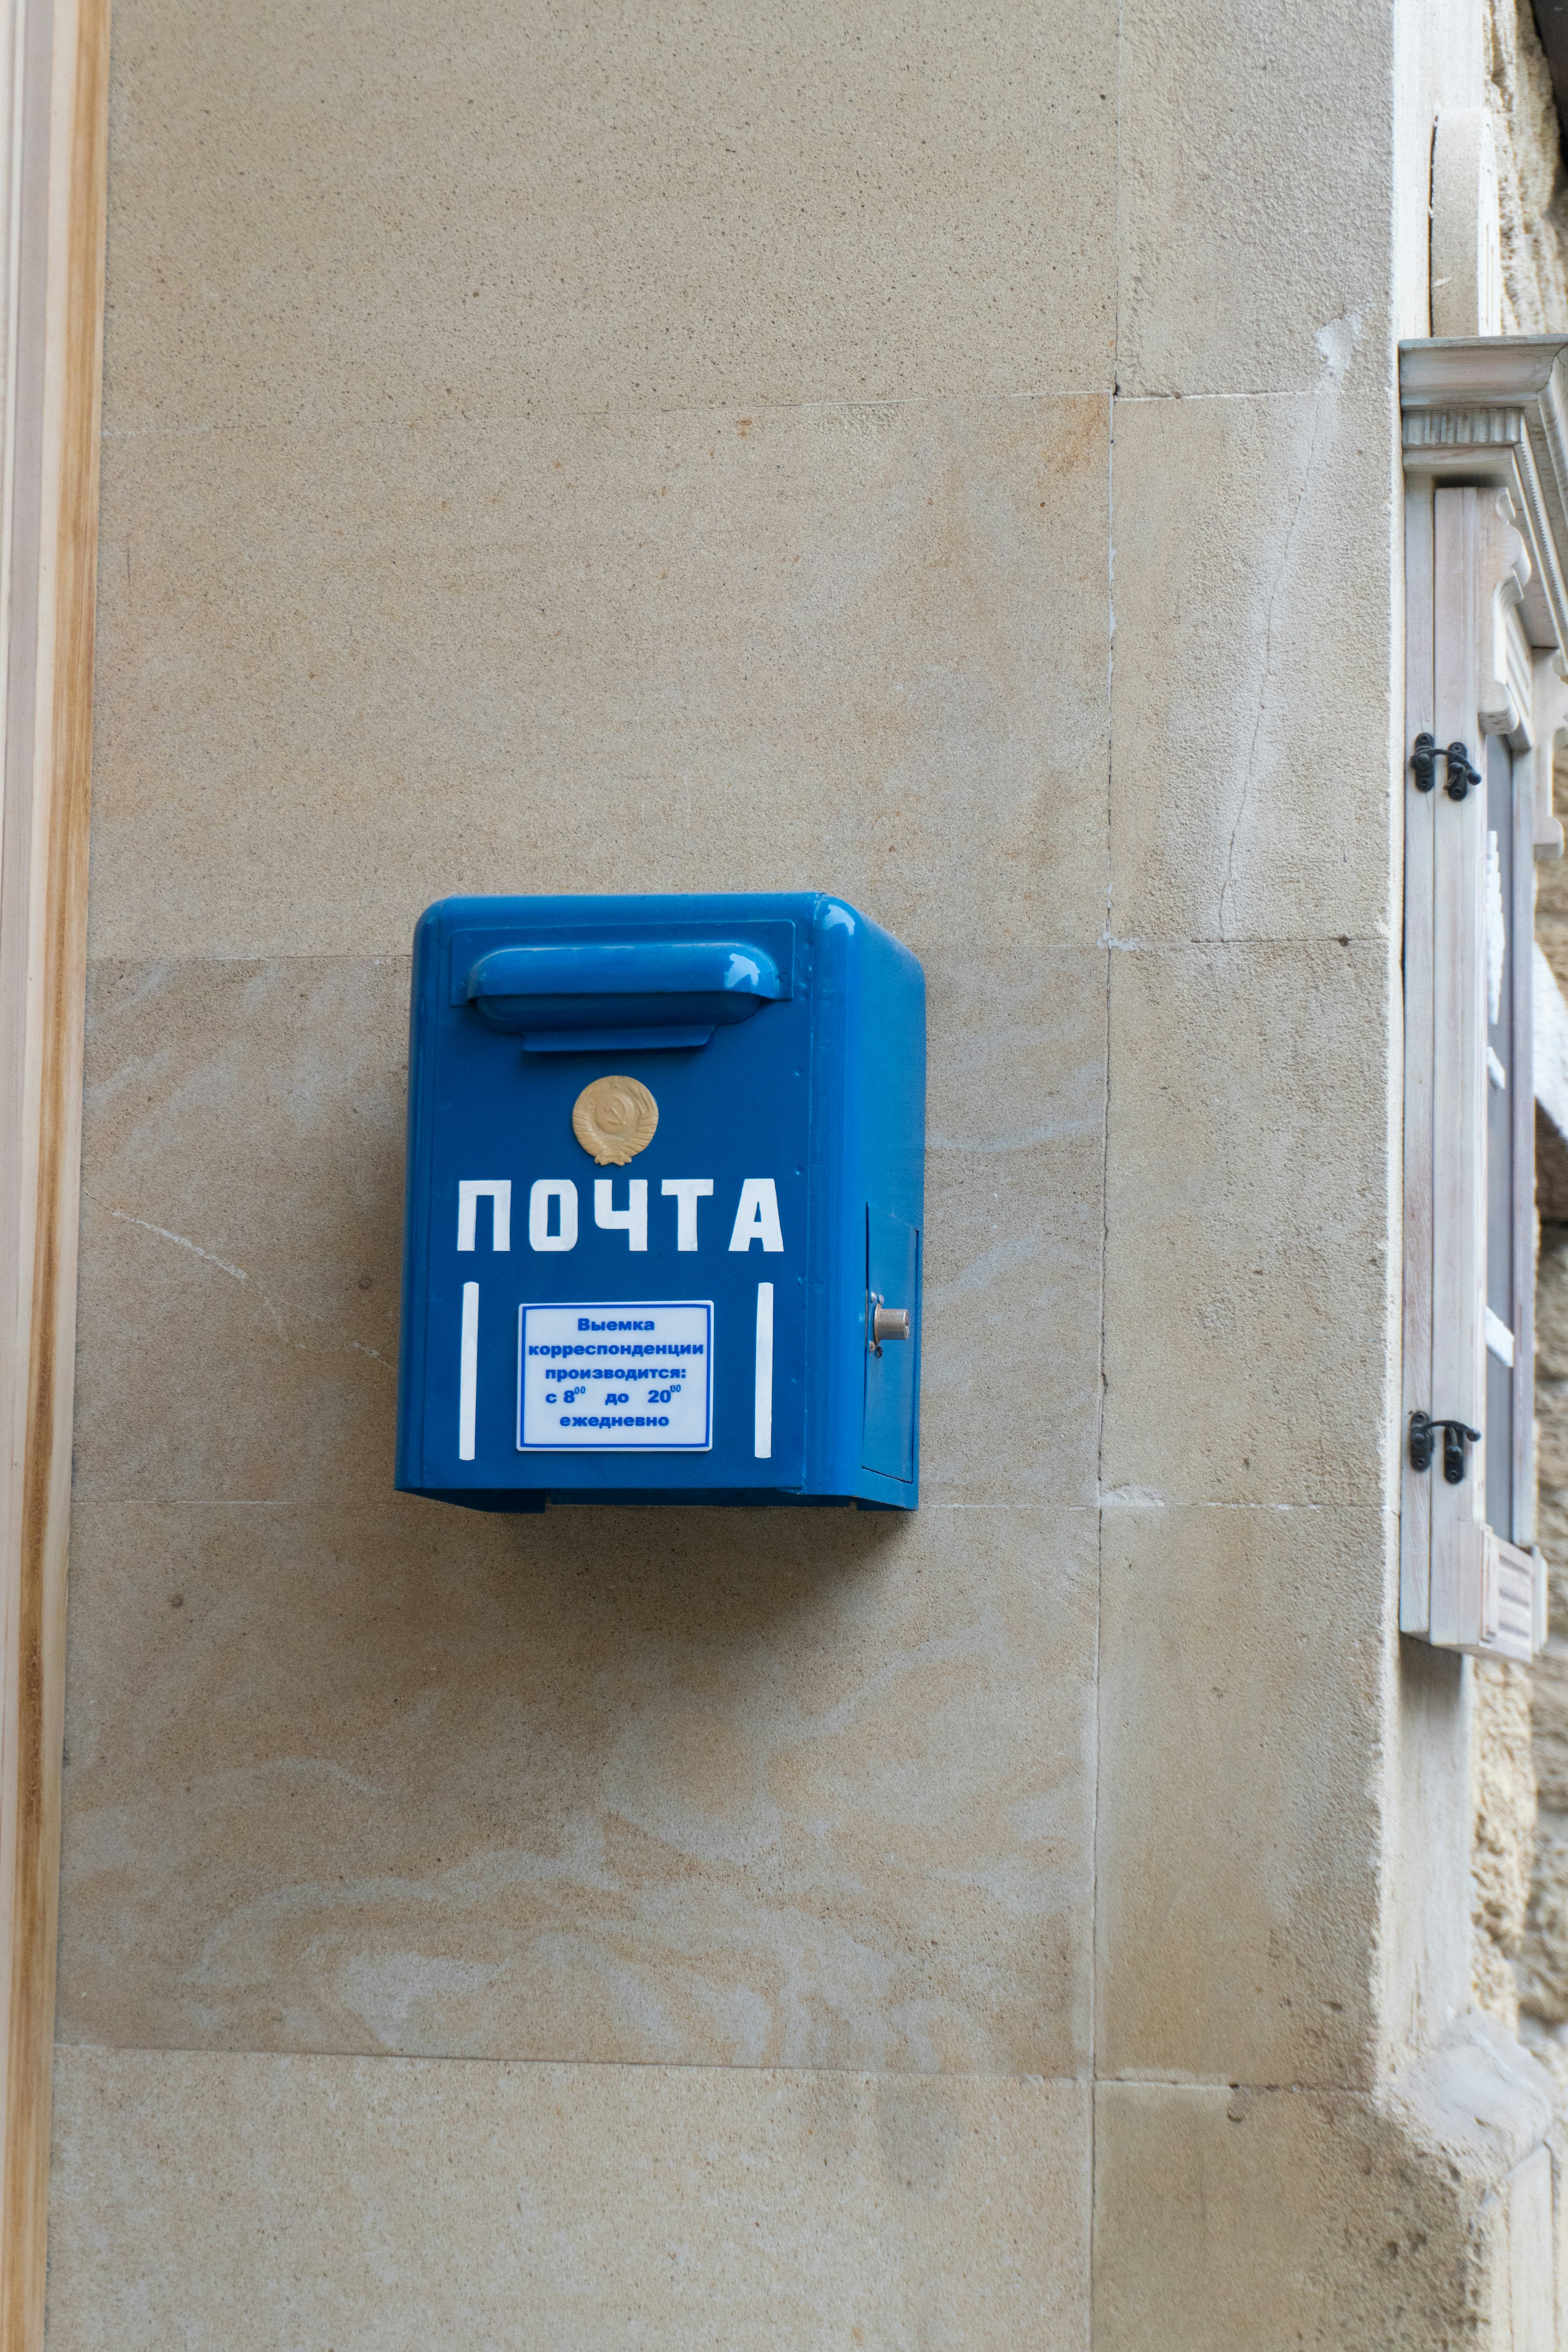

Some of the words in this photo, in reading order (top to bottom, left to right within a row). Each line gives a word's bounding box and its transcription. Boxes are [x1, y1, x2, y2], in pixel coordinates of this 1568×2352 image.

[457, 1178, 784, 1252] ПОЧТА
[578, 1318, 655, 1331] Выемка
[528, 1344, 704, 1359] корреспонденции
[545, 1369, 686, 1382] производится:
[545, 1394, 557, 1404] с
[605, 1393, 629, 1405] до
[559, 1416, 670, 1429] ежедневно
